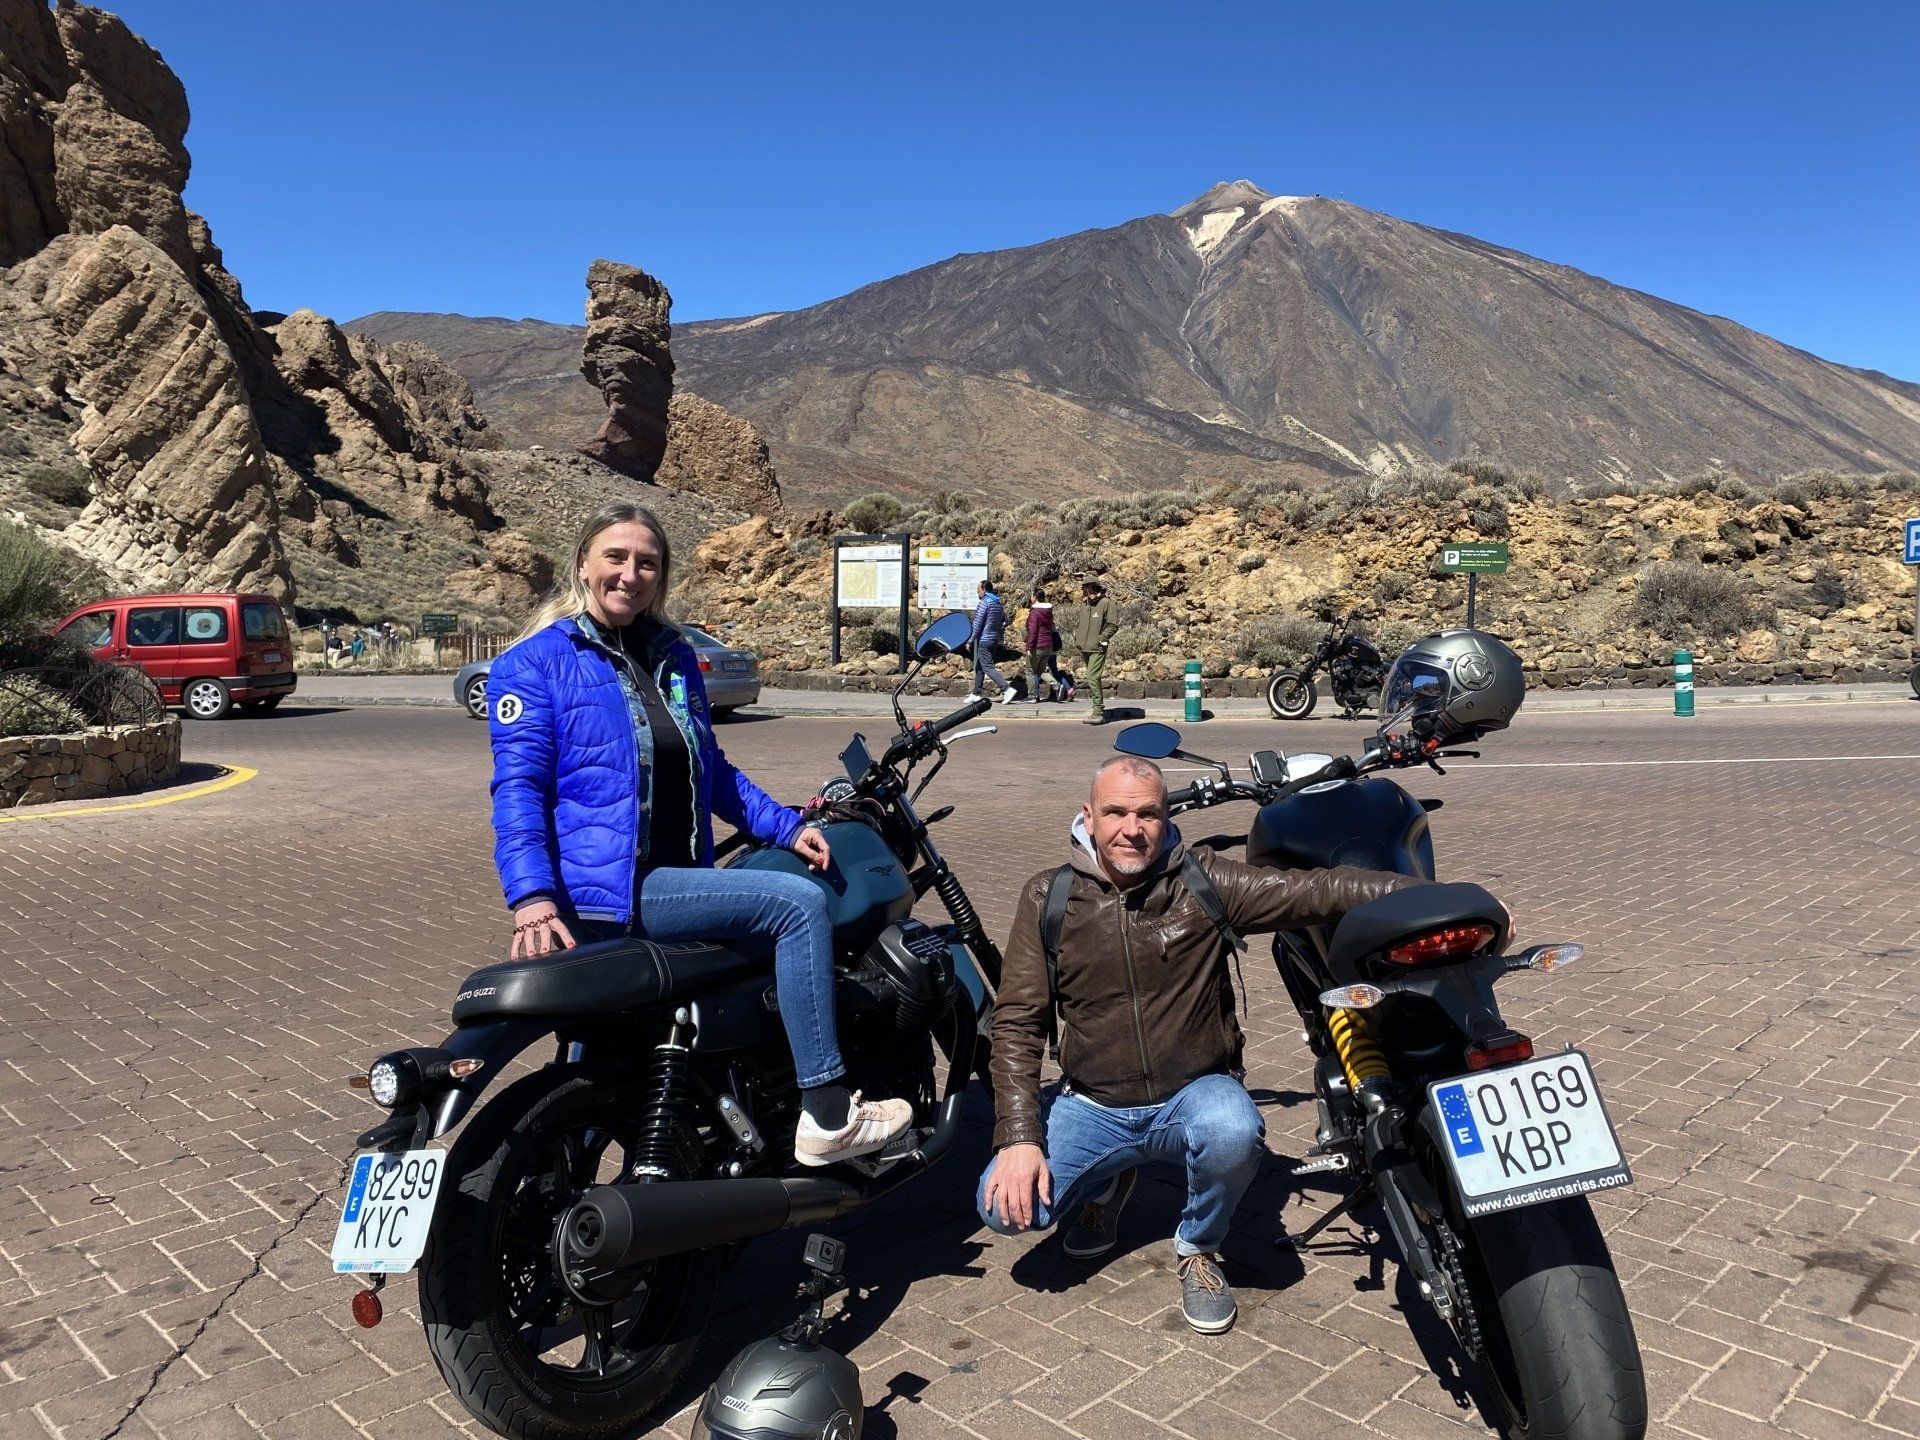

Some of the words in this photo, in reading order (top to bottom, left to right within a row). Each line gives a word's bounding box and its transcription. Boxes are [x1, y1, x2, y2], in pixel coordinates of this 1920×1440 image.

[1447, 552, 1456, 563] P
[501, 699, 516, 719] 3
[473, 987, 497, 998] GUZZI
[1477, 1065, 1587, 1126] 0169
[1456, 1127, 1473, 1145] E
[1492, 1120, 1572, 1178] KBP
[368, 1158, 437, 1201] 8299
[1467, 1172, 1629, 1215] www.ducaticanarias.com
[349, 1197, 359, 1212] E
[354, 1206, 409, 1249] KYC
